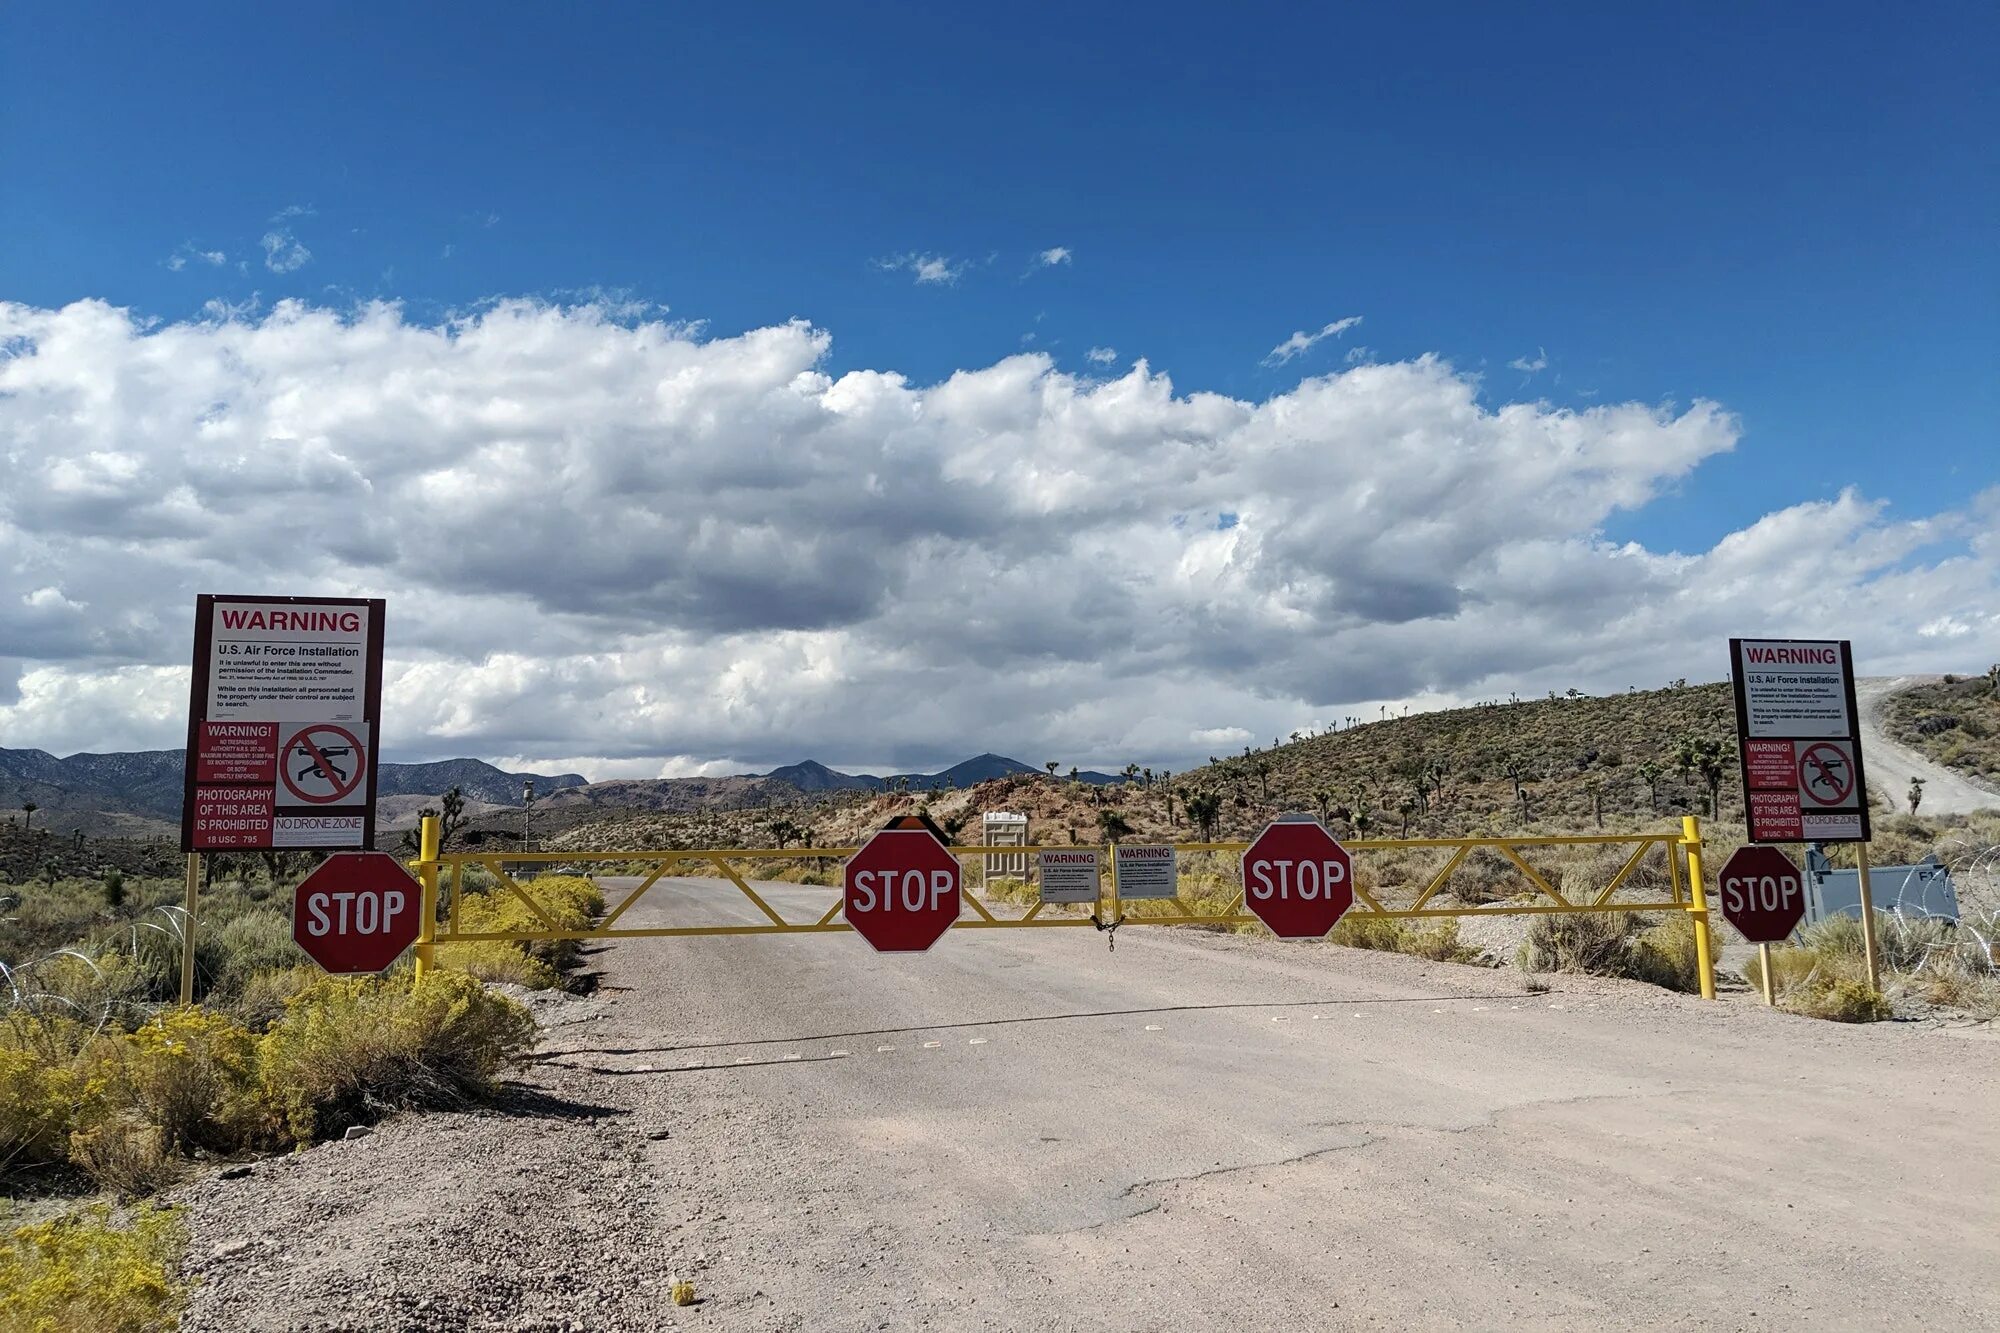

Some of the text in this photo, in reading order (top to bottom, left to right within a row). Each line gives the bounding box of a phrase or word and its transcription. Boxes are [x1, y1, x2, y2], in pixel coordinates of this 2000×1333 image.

[222, 610, 360, 632] WARNING
[218, 645, 359, 656] U.S. Air Force Installation
[1746, 648, 1836, 664] WARNING
[208, 726, 271, 736] WARNING!
[1749, 744, 1790, 752] WARNING!
[197, 790, 272, 800] PHOTOGRAPHY
[200, 805, 267, 815] OF THIS AREA
[1754, 806, 1797, 815] OF THIS AREA
[197, 820, 268, 830] IS PROHIBITED
[276, 818, 362, 829] NO DRONE ZONE
[1754, 818, 1799, 826] IS PROHIBITED
[1804, 816, 1858, 824] NO DRONE ZONE
[1120, 849, 1170, 858] WARNING
[1044, 854, 1094, 864] WARNING
[1252, 860, 1344, 900] STOP
[853, 870, 953, 912] STOP
[1726, 876, 1797, 912] STOP
[308, 891, 405, 936] STOP
